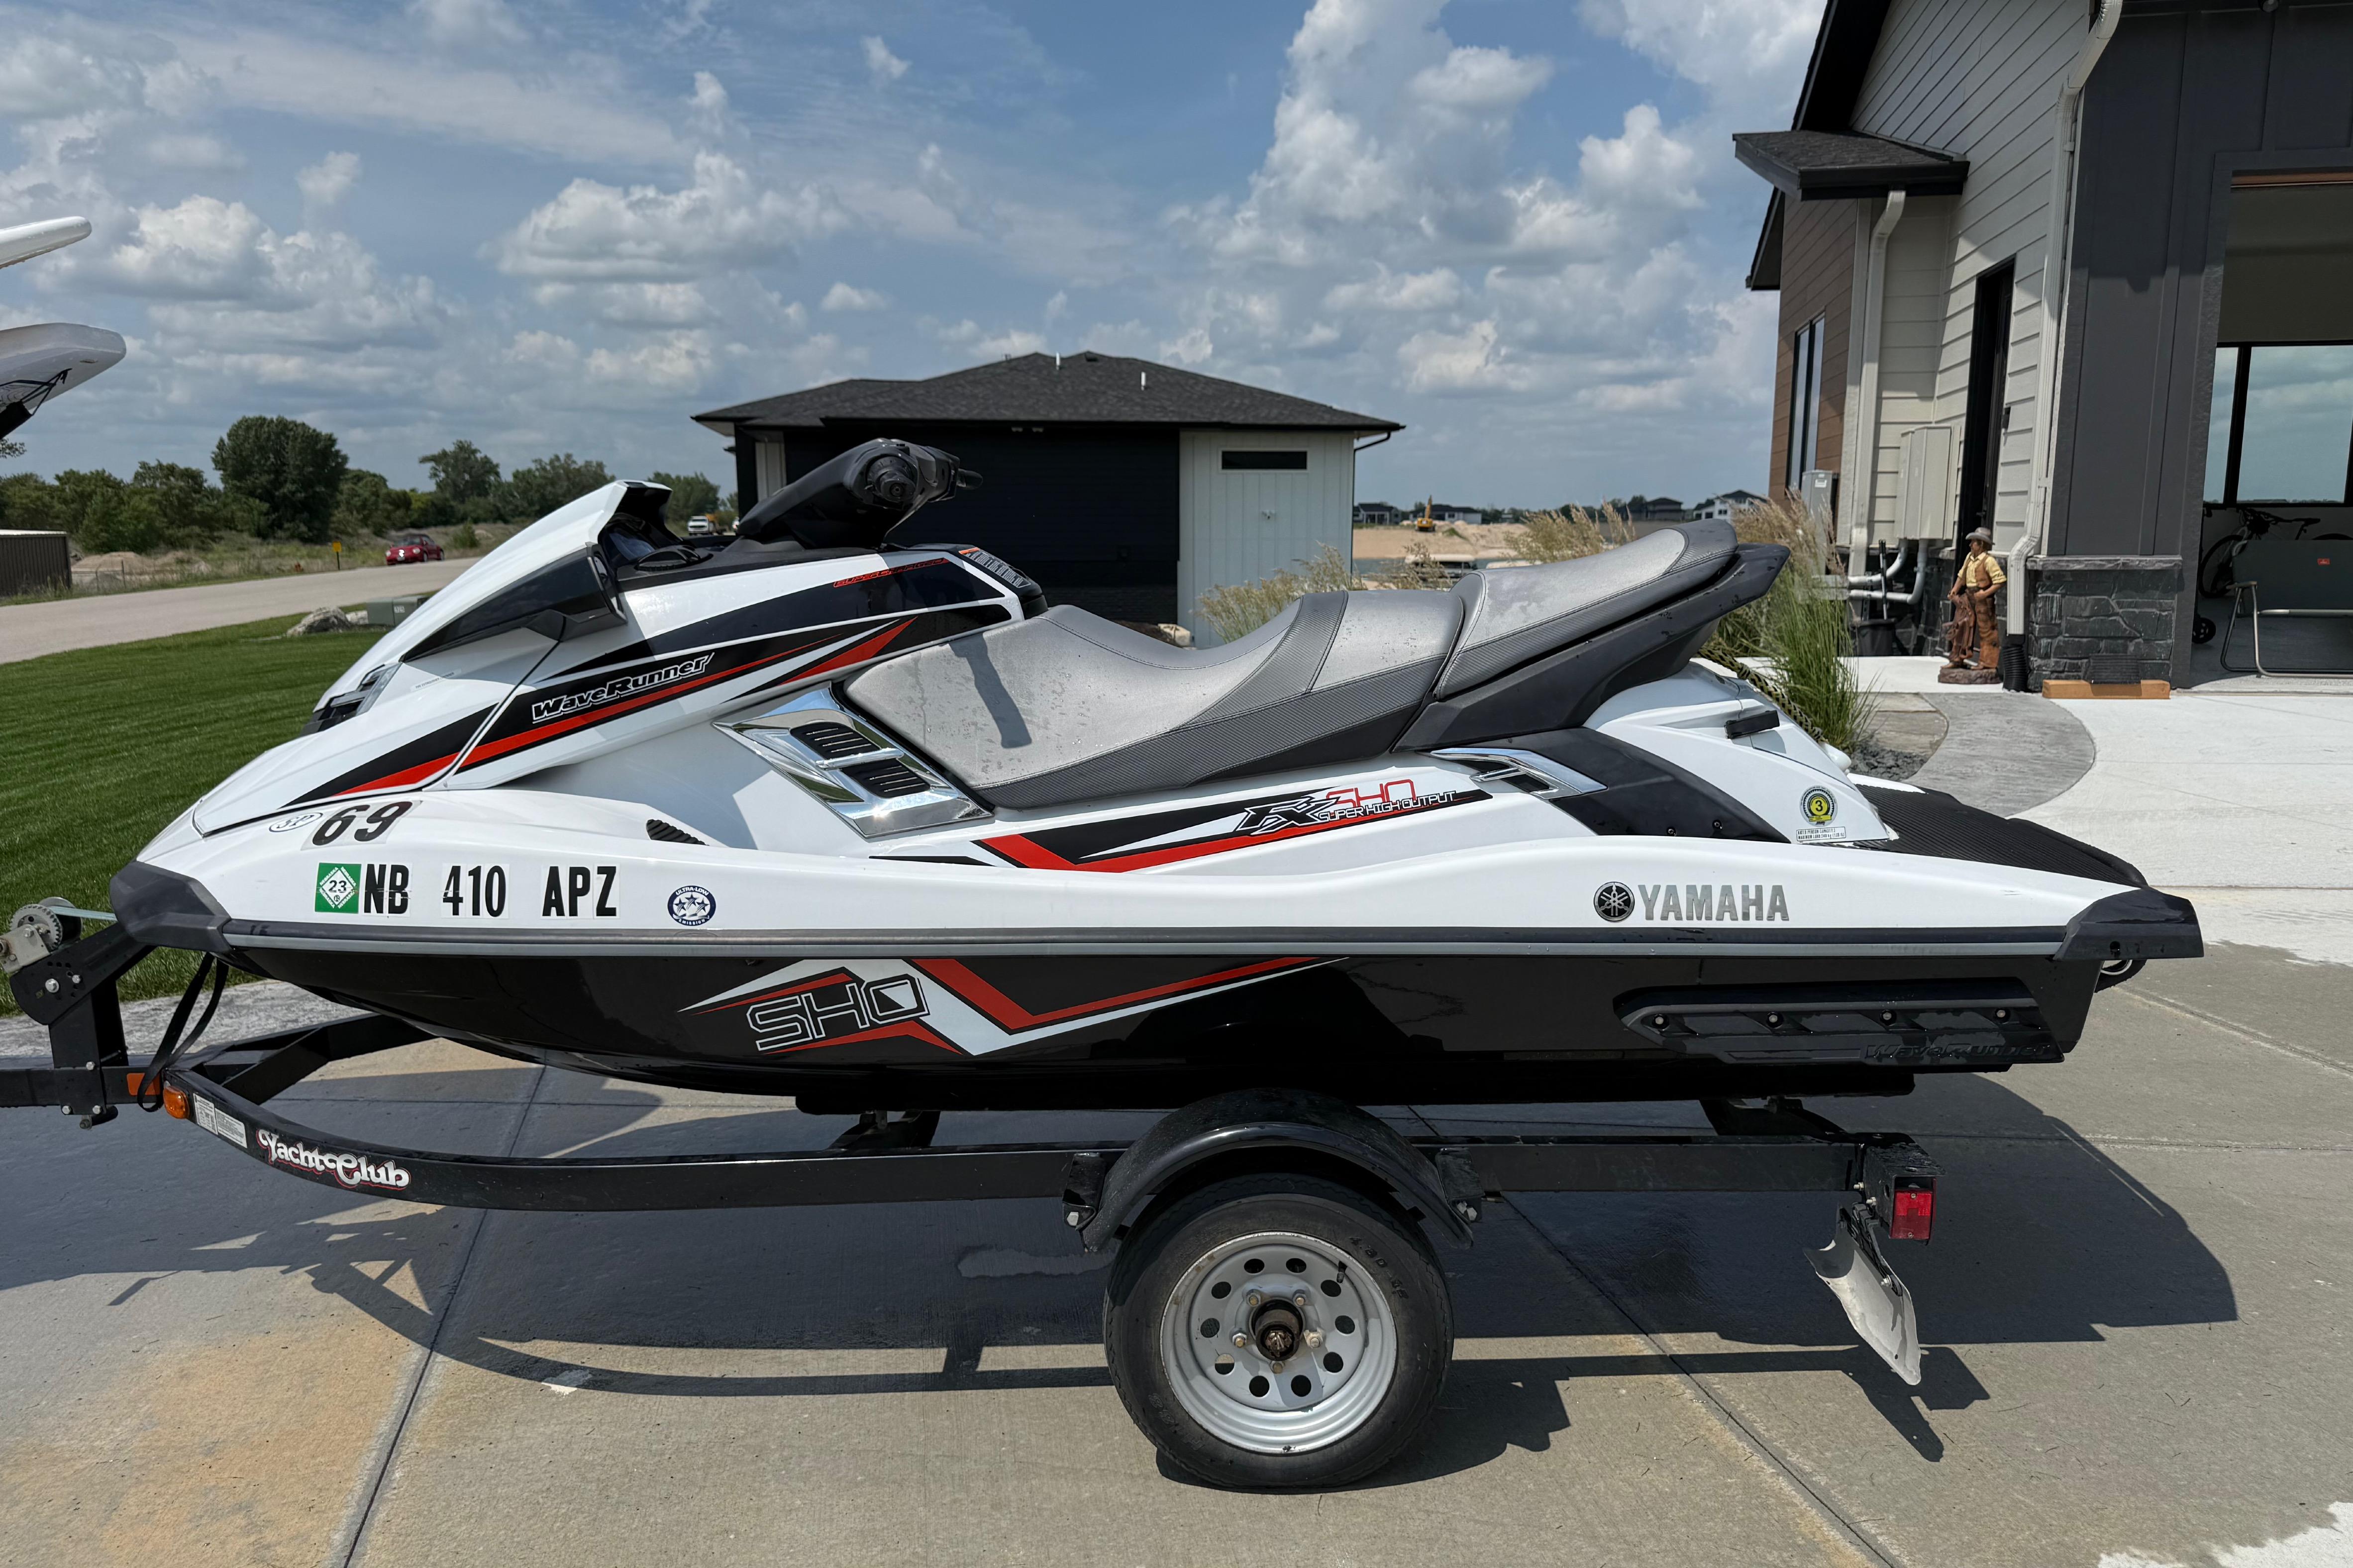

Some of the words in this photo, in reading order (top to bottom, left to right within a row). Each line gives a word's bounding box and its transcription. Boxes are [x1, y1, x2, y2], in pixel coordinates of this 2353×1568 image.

[532, 652, 715, 724] WaveRunner
[1319, 806, 1364, 822] SUPER
[1366, 801, 1399, 815] HIGH
[1402, 791, 1456, 808] OUTPUT
[1326, 779, 1417, 808] SHO
[1815, 800, 1823, 812] 3
[312, 801, 413, 847] 69
[328, 880, 347, 893] 23
[364, 864, 409, 914] NB
[442, 866, 506, 917] 410
[542, 866, 617, 917] APZ
[1637, 884, 1790, 921] YAMAHA
[746, 973, 930, 1051] SHO
